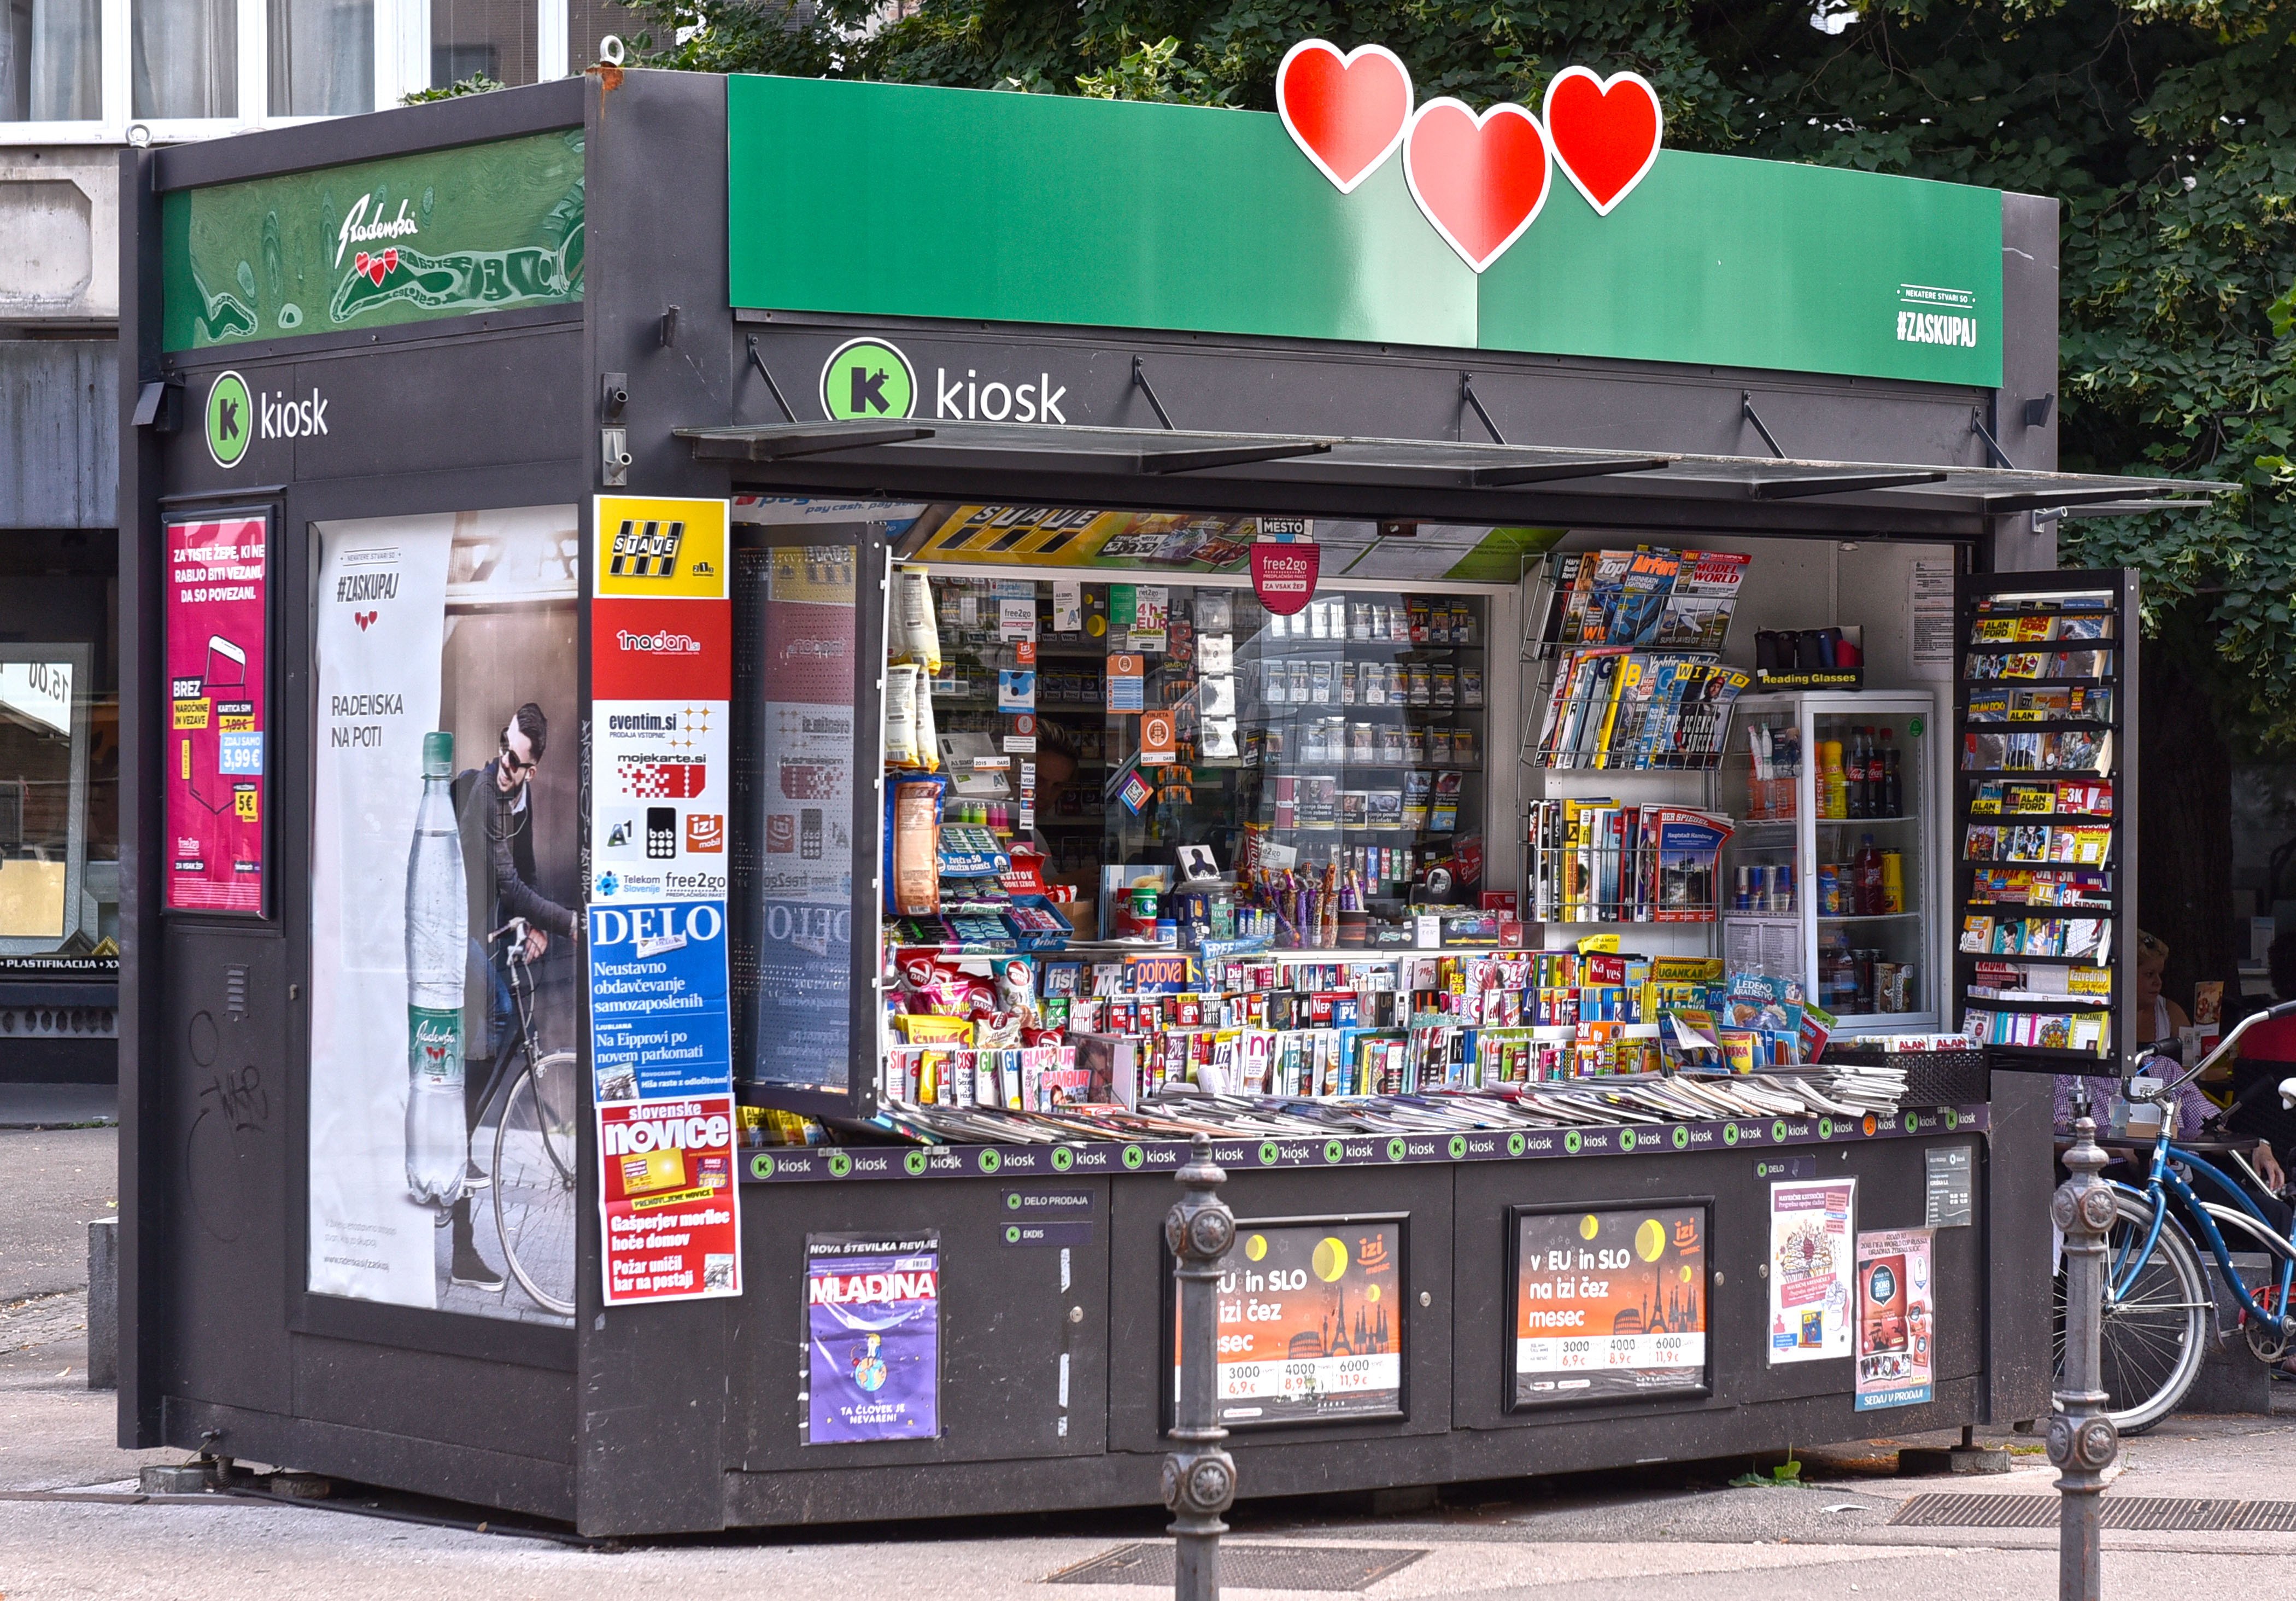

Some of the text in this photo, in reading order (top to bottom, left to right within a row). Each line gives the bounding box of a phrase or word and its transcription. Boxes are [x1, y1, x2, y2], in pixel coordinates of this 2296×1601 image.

[1906, 289, 1936, 299] NEKATERE
[1937, 293, 1958, 301] STVARI
[1897, 311, 1976, 347] #ZASKUPAJ
[936, 367, 1066, 424] kiosk
[261, 388, 328, 439] kiosk
[1264, 523, 1303, 533] MESTO
[615, 536, 674, 554] STAVE
[174, 544, 265, 562] ZA TISTE ŽEPE, KI NE
[1263, 556, 1307, 573] free2go
[1695, 562, 1738, 573] MODEL
[175, 565, 262, 583] RABIJO BITI VEZANI,
[1694, 573, 1739, 584] WORLD
[1627, 575, 1659, 586] LAKENHEATH
[337, 573, 399, 602] #ZASKUPAJ
[1139, 589, 1158, 597] net2go
[181, 586, 256, 603] DA SO POVEZANI.
[1005, 609, 1031, 619] free2go
[1137, 617, 1168, 630] EUR
[1985, 621, 2009, 629] ALAN
[1983, 629, 2007, 638] FORD
[1020, 642, 1031, 651] izi
[1677, 663, 1750, 687] WIRED
[1762, 673, 1855, 685] Reading Glasses
[173, 681, 201, 697] BREZ
[175, 702, 208, 714] NAROČNINE
[218, 704, 239, 712] KARTICA
[332, 693, 403, 716] RADENSKA
[1970, 702, 1989, 712] DYLAN
[175, 715, 206, 725] IN VEZAVE
[2010, 712, 2034, 720] ALAN
[609, 713, 677, 732] eventim.si
[224, 736, 260, 746] ZDAJ SAMO
[332, 726, 382, 747] NA POTI
[618, 753, 706, 763] mojekarte.si
[2020, 794, 2046, 804] ALAN
[1973, 803, 1995, 811] ALAN
[2019, 803, 2045, 811] FORD
[691, 815, 714, 834] izi
[1662, 812, 1708, 826] DER SPIEGEL
[607, 820, 631, 847] A1
[649, 828, 673, 839] bob
[699, 838, 721, 849] mobil
[624, 875, 660, 884] Telekom
[666, 872, 726, 892] free2go
[624, 885, 660, 895] Slovenije
[593, 905, 722, 945] DELO
[7, 960, 97, 968] PLASTIFIKACIJA
[594, 961, 666, 977] Neustavno
[1011, 972, 1028, 983] DAYS
[2070, 972, 2106, 983] Razvedrilo
[594, 977, 686, 995] obdavčevanje
[1736, 979, 1772, 993] LEDENO
[1733, 988, 1773, 1001] KRALJESTVO
[595, 993, 703, 1014] samozaposlenih
[974, 1000, 992, 1012] DAYS
[1071, 999, 1090, 1016] Auto
[1072, 1016, 1090, 1032] Bild
[1203, 1013, 1219, 1024] ARTS
[597, 1031, 687, 1049] Na Eipprovi po
[598, 1045, 703, 1064] novem parkomati
[1041, 1071, 1089, 1088] GLAMOUR
[629, 1101, 701, 1119] slovenske
[1878, 1118, 1896, 1130] kiosk
[1741, 1127, 1762, 1139] kiosk
[1584, 1135, 1607, 1147] kiosk
[1409, 1142, 1434, 1154] kiosk
[1004, 1154, 1035, 1167] kiosk
[1215, 1149, 1243, 1161] kiosk
[778, 1160, 811, 1173] kiosk
[1024, 1196, 1088, 1205] DELO PRODAJA
[611, 1208, 730, 1233] Gašperjev morilec
[1023, 1230, 1044, 1238] EKDIS
[1675, 1217, 1694, 1241] izi
[612, 1232, 690, 1251] hoče domov
[810, 1239, 938, 1254] NOVA ŠTEVILKA REVIJE
[1359, 1234, 1383, 1258] izi
[1680, 1245, 1700, 1256] mesec
[613, 1255, 682, 1276] Požar uničil
[1531, 1248, 1630, 1271] v EU in SLO
[1366, 1262, 1390, 1274] mesec
[613, 1270, 693, 1292] bar na postaji
[1875, 1281, 1890, 1289] 2018
[810, 1273, 936, 1304] MLADINA
[1530, 1276, 1609, 1299] na izi čez
[1220, 1299, 1281, 1323] izi čez
[1530, 1310, 1585, 1328] mesec
[1563, 1341, 1589, 1352] 3000
[1610, 1339, 1635, 1351] 4000
[1656, 1337, 1681, 1349] 6000
[1229, 1366, 1260, 1378] 3000
[1285, 1363, 1315, 1375] 4000
[1340, 1360, 1369, 1372] 6000
[1864, 1389, 1923, 1406] SEDAJ V PRODAJI
[841, 1404, 905, 1416] TA ČLOVEK JE
